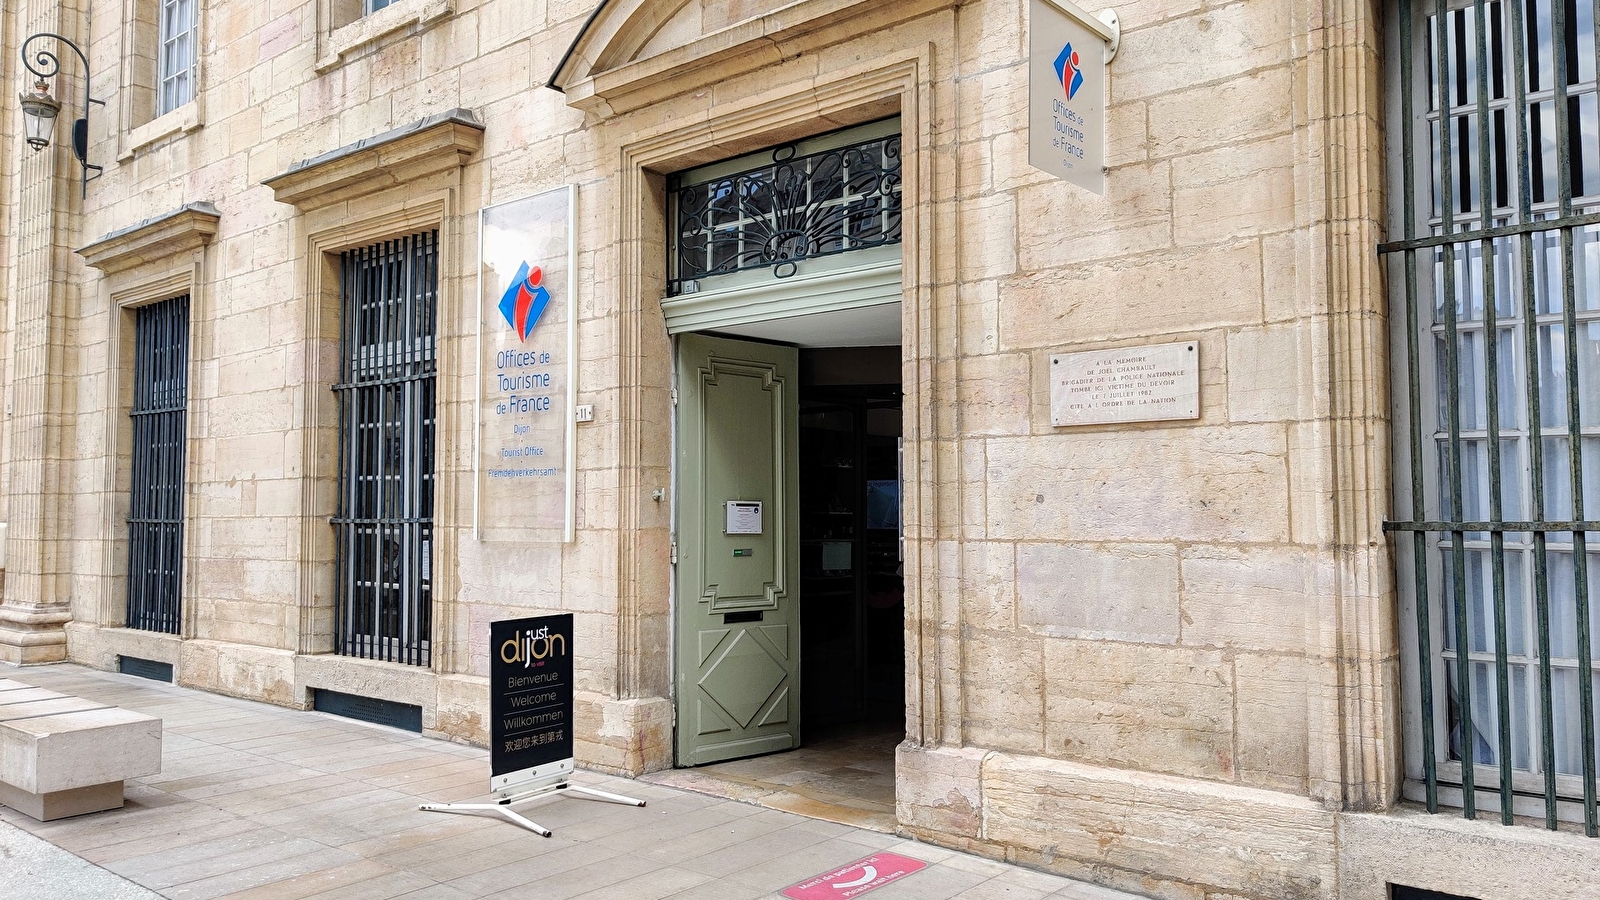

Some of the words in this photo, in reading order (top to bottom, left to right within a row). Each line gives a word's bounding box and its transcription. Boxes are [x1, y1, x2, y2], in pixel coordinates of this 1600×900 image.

[1053, 98, 1076, 122] Offices
[1077, 116, 1084, 126] de
[1053, 115, 1084, 142] Tourisme
[1053, 137, 1059, 148] de
[1061, 136, 1084, 160] France
[497, 349, 536, 369] Offices
[540, 350, 550, 364] de
[497, 371, 550, 392] Tourisme
[1147, 370, 1185, 378] NATIONALE
[496, 402, 506, 414] de
[510, 395, 550, 413] France
[580, 408, 586, 420] 11
[514, 424, 530, 435] Dijon
[502, 448, 522, 458] Tourist
[525, 446, 544, 456] Office
[508, 672, 558, 688] Bienvenue
[510, 692, 557, 707] Welcome
[504, 710, 563, 730] Willkommen
